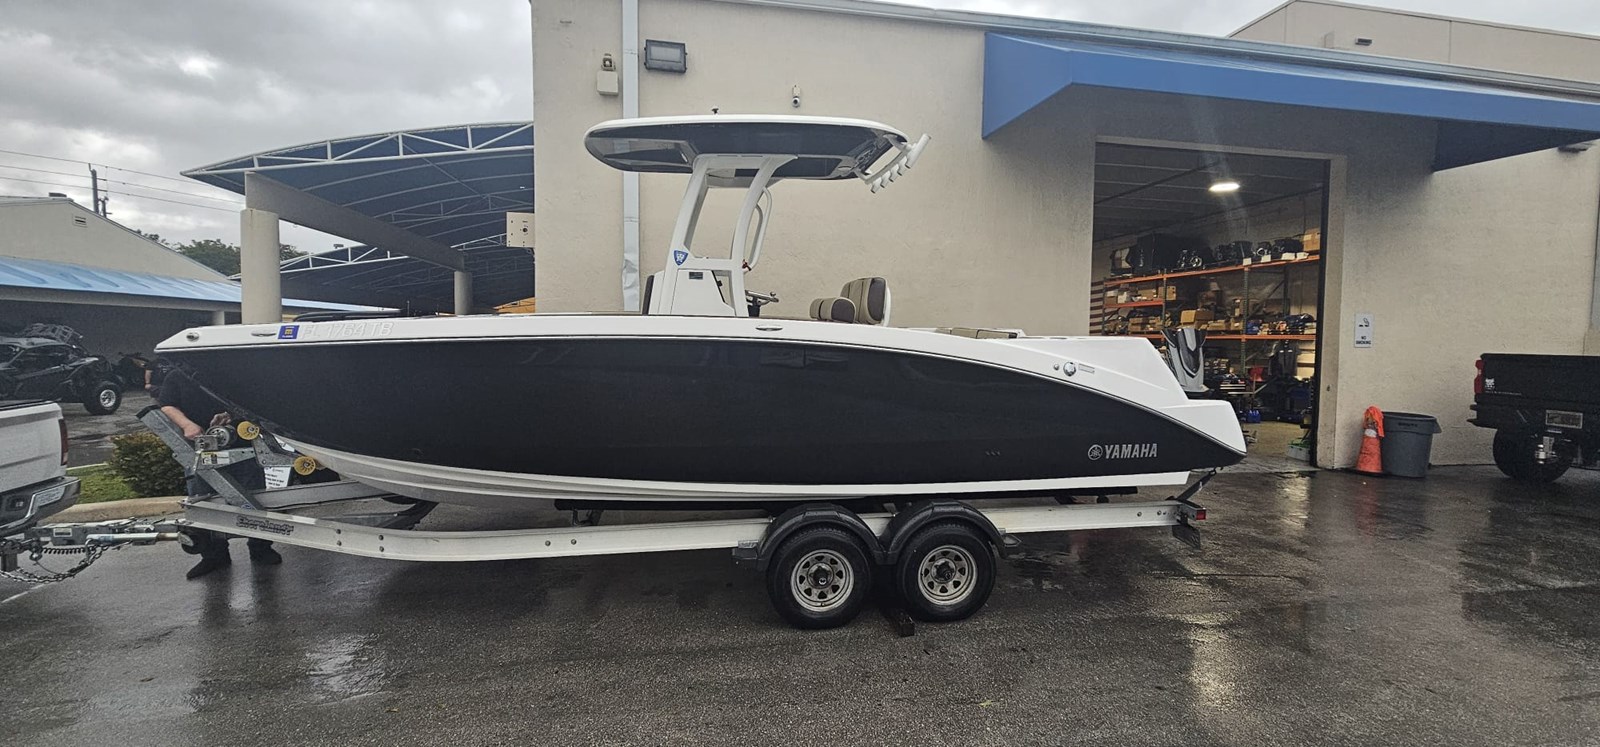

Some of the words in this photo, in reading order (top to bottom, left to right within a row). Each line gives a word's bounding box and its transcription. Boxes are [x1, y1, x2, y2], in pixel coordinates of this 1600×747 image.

[301, 324, 321, 338] FL
[326, 322, 367, 337] 1764
[369, 321, 395, 336] TB
[1105, 443, 1158, 459] YAMAHA
